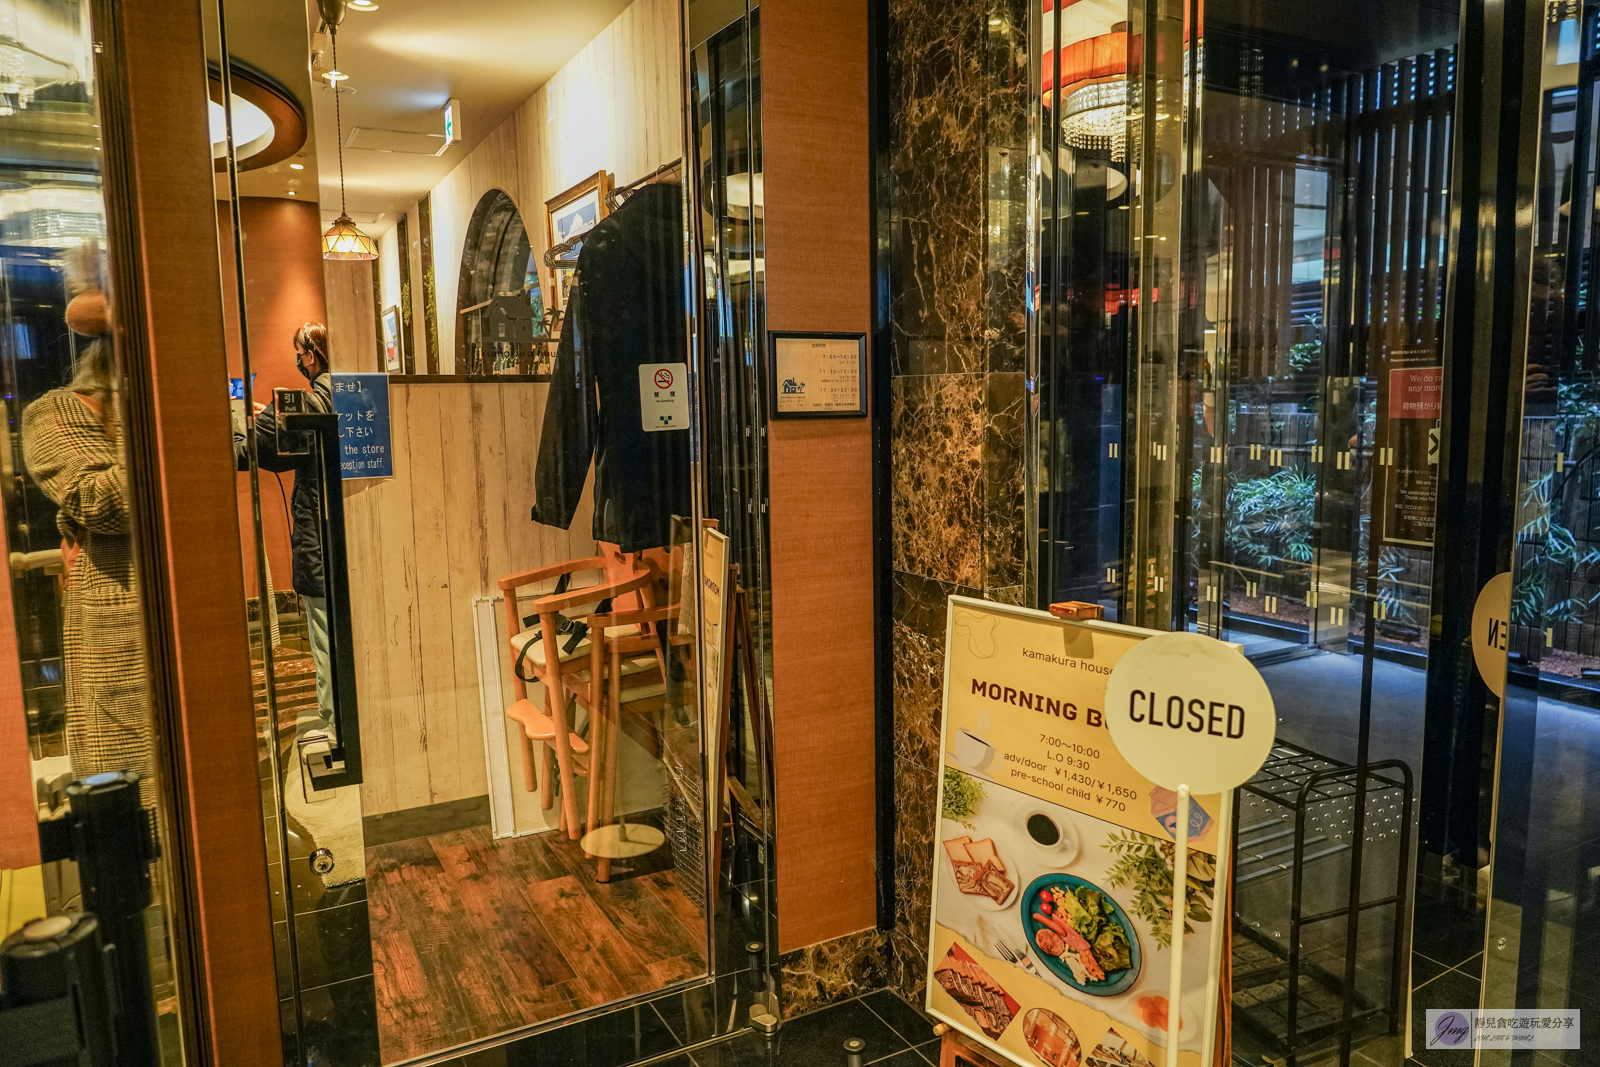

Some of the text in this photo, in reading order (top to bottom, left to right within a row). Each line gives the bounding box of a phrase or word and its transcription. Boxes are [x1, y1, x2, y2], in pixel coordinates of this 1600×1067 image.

[1423, 374, 1433, 382] do
[344, 444, 385, 455] the store
[367, 458, 385, 469] staff.
[1022, 647, 1077, 668] kamakura
[971, 678, 1109, 730] MORNING B
[1129, 689, 1245, 740] CLOSED
[1003, 752, 1048, 772] adv/door
[1046, 750, 1090, 771] L.O 9:30
[1010, 768, 1063, 792] pre-school
[1066, 786, 1091, 801] child
